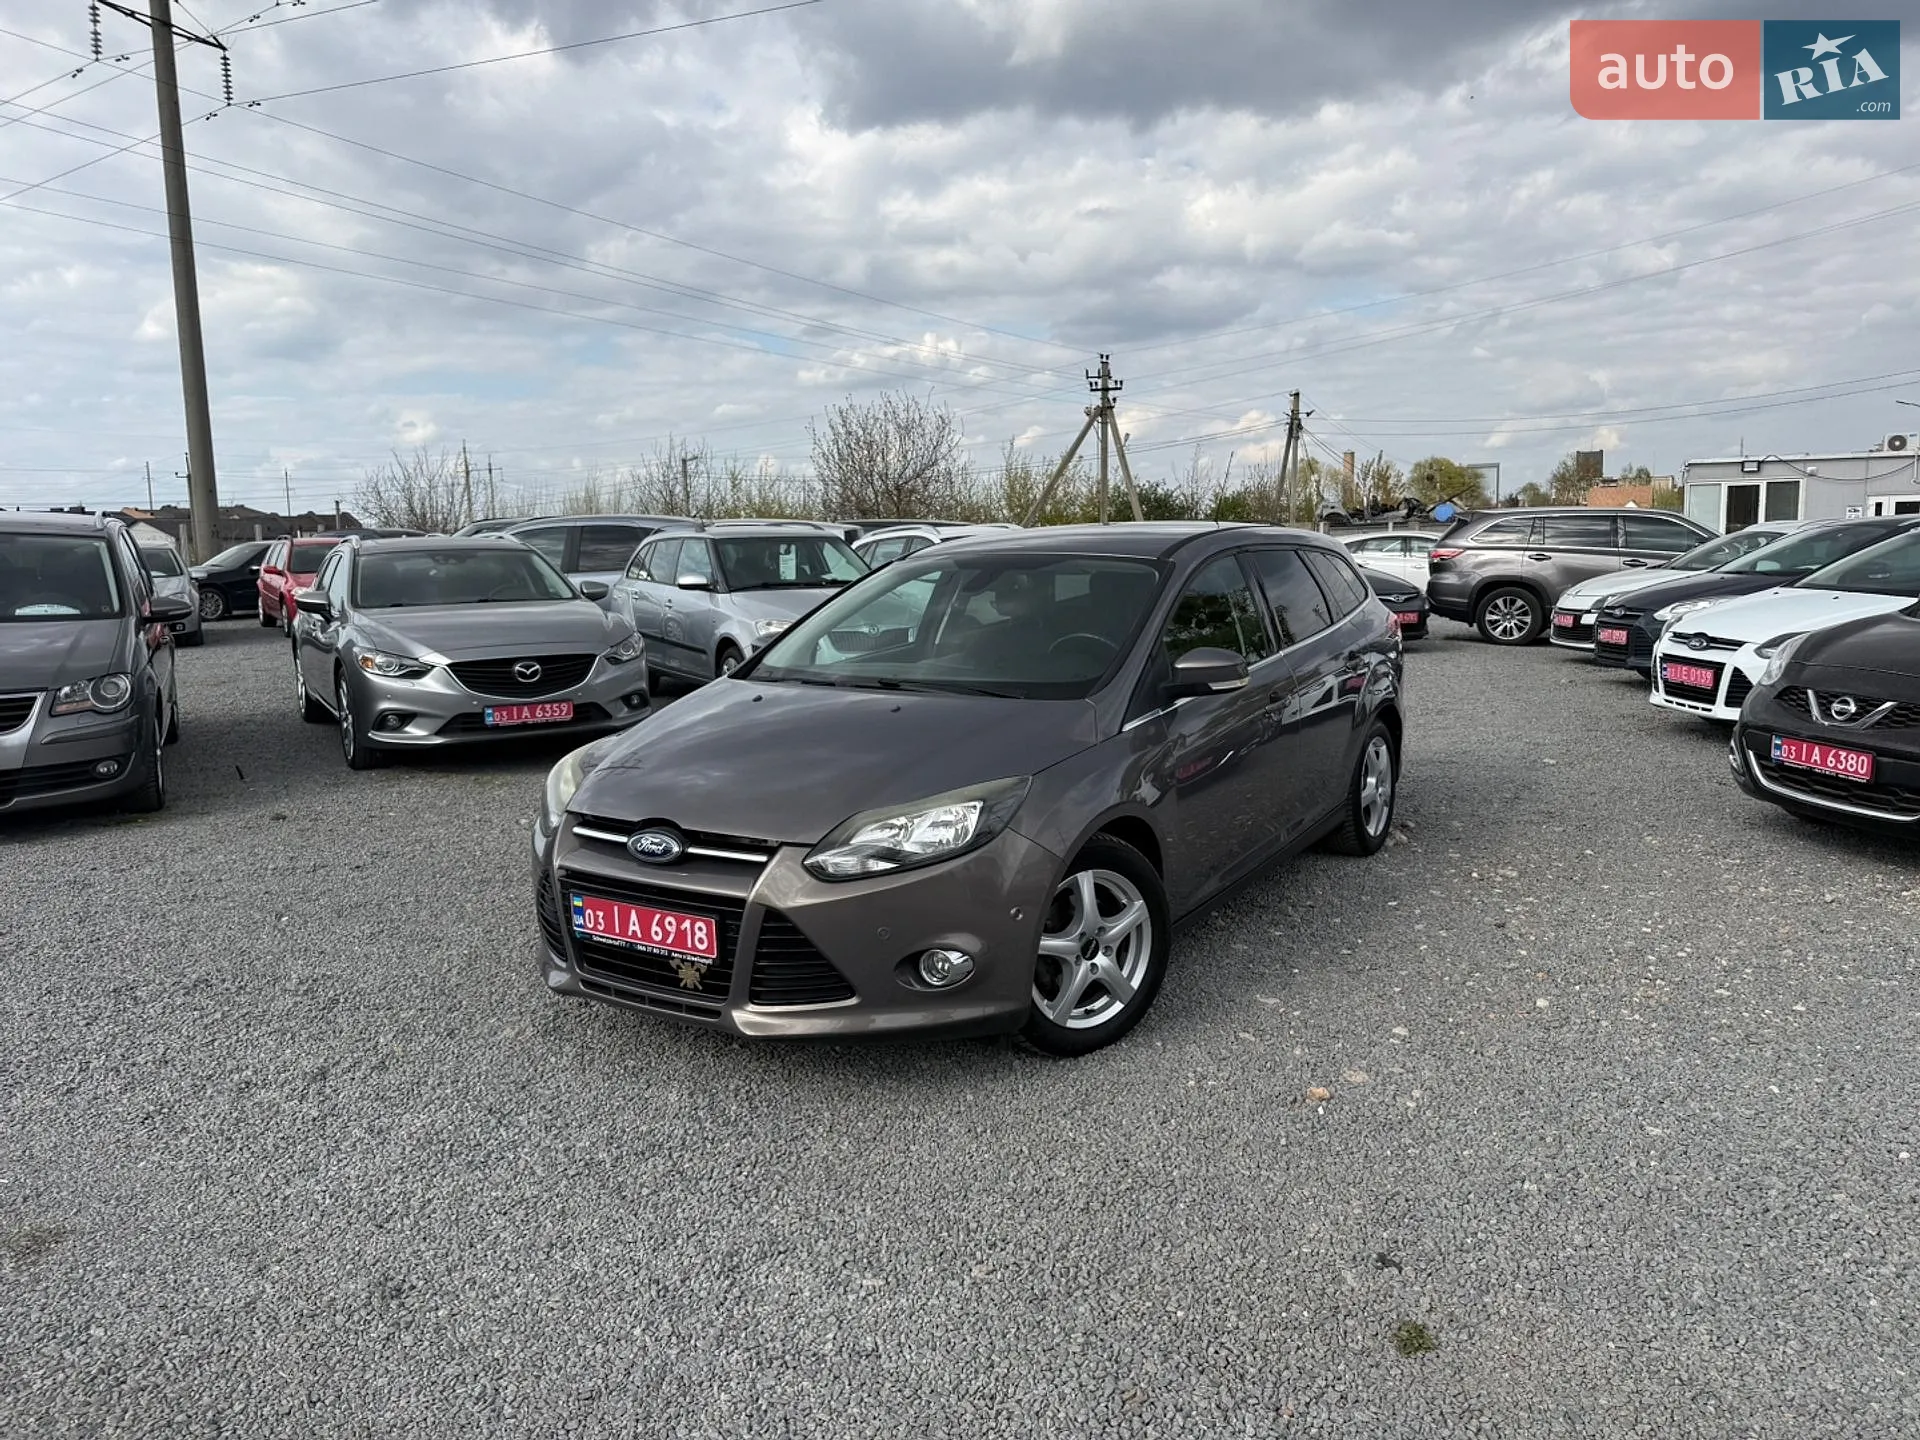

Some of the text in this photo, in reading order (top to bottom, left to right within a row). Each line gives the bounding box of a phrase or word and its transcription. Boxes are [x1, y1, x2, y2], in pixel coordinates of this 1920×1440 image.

[494, 711, 508, 722] 03
[513, 705, 531, 720] IA
[536, 703, 568, 718] 6359
[1781, 745, 1796, 759] 03
[1802, 743, 1820, 765] IA
[1826, 749, 1868, 775] 6380
[637, 836, 667, 855] Ford
[585, 908, 605, 931] 03
[614, 906, 642, 938] IA
[651, 913, 709, 951] 6918
